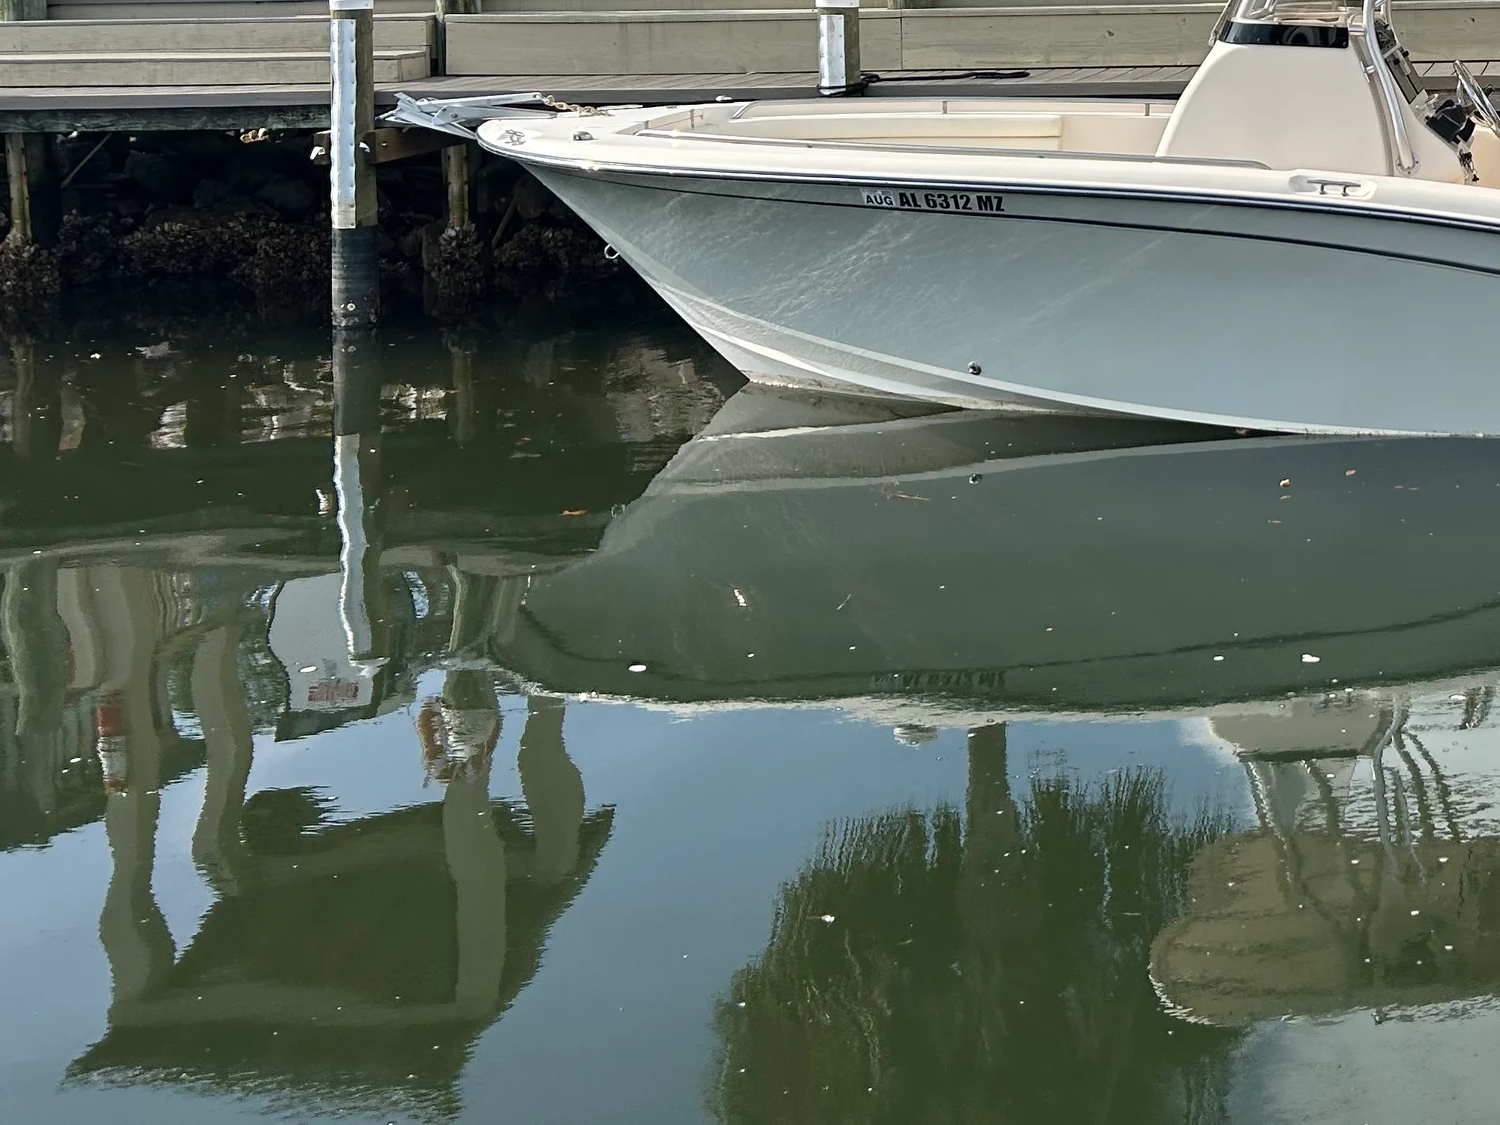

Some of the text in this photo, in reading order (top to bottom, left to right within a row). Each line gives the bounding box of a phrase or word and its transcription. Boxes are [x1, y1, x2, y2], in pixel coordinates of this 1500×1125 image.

[866, 194, 894, 206] AUG
[899, 192, 921, 208] AL
[924, 193, 972, 211] 6312
[976, 195, 1005, 212] MZ
